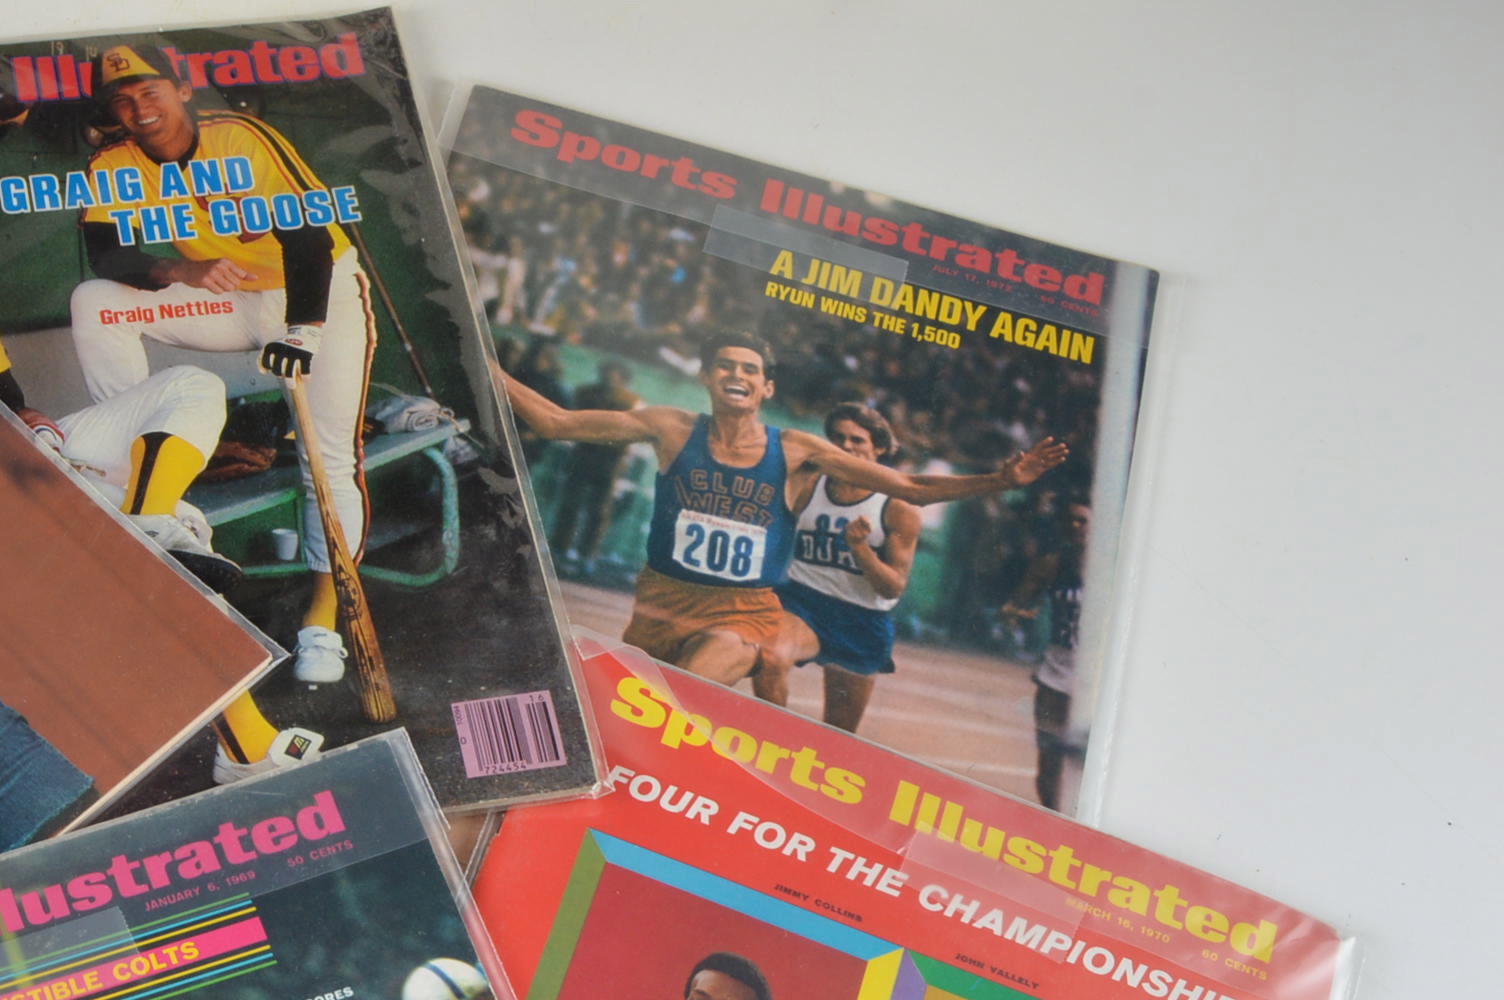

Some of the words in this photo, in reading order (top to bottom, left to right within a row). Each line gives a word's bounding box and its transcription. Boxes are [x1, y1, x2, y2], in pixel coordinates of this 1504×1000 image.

[159, 155, 255, 200] AND
[510, 109, 738, 199] Sports
[760, 178, 1106, 305] Illustrated
[109, 202, 198, 247] THE
[207, 185, 362, 237] GOOSE
[100, 304, 155, 325] Graig
[159, 300, 234, 320] Nettles
[765, 281, 815, 309] RYUN
[819, 295, 867, 323] WINS
[873, 311, 907, 335] THE
[911, 322, 961, 350] 1,500
[769, 250, 794, 279] A
[801, 258, 865, 298] JIM
[869, 275, 987, 331] DANDY
[989, 311, 1095, 364] AGAIN
[690, 468, 776, 508] CLUB
[683, 522, 754, 577] 208
[607, 764, 719, 825] FOUR
[726, 811, 816, 862] FOR
[826, 847, 909, 897] THE
[610, 676, 867, 805] Sports
[888, 779, 1278, 964] Illustrated
[145, 887, 201, 912] JANUARY
[226, 870, 256, 887] 1969
[287, 856, 304, 868] 50
[310, 840, 354, 860] CENTS
[773, 883, 809, 902] JIMMY
[814, 899, 864, 923] COLLINS
[112, 941, 200, 983] COLTS
[1065, 897, 1112, 922] MARCH
[1117, 916, 1135, 932] 16,
[1140, 924, 1171, 944] 1970
[1201, 947, 1219, 963] 60
[1224, 956, 1268, 981] CENTS
[955, 952, 985, 970] JOHN
[990, 964, 1040, 990] VALLELY
